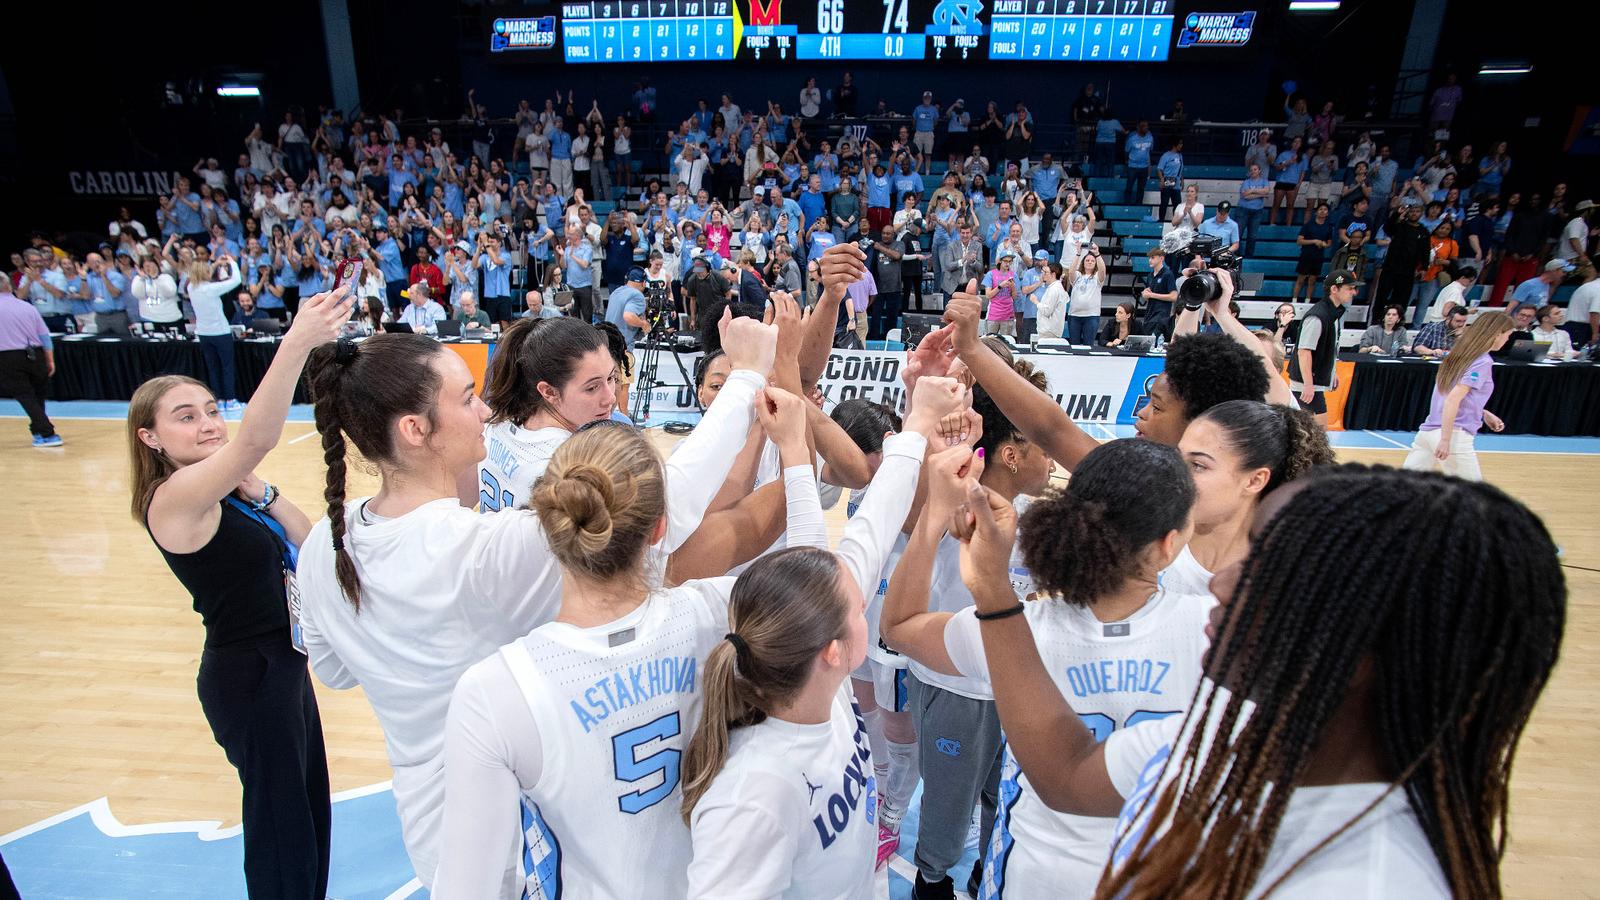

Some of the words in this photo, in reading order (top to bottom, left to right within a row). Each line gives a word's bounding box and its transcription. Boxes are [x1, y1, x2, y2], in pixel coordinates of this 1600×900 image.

[563, 5, 589, 17] PLAYER
[603, 5, 611, 16] 3
[631, 4, 639, 16] 6
[660, 4, 667, 16] 7
[685, 3, 699, 15] 10
[713, 3, 727, 15] 12
[993, 1, 1022, 13] PLAYER
[1036, 1, 1045, 13] 0
[1066, 1, 1075, 13] 2
[1096, 1, 1105, 14] 7
[1123, 1, 1138, 14] 17
[1151, 1, 1166, 14] 21
[817, 0, 844, 34] 66
[882, 0, 909, 34] 74
[1197, 15, 1236, 28] MARCH
[505, 20, 538, 32] MARCH
[564, 26, 590, 37] POINTS
[603, 26, 615, 38] 13
[632, 25, 640, 37] 2
[657, 25, 669, 37] 21
[686, 24, 698, 36] 12
[992, 22, 1020, 33] POINTS
[1031, 23, 1046, 35] 20
[1062, 23, 1076, 35] 14
[1119, 23, 1134, 35] 21
[1152, 24, 1161, 36] 2
[509, 32, 554, 44] MADNESS
[1200, 28, 1250, 41] MADNESS
[746, 36, 770, 48] FOULS
[776, 36, 791, 48] TOL
[819, 36, 841, 57] 4TH
[884, 36, 904, 57] 0.0
[933, 36, 947, 48] TOL
[955, 36, 979, 48] FOULS
[567, 46, 590, 57] FOULS
[605, 47, 613, 59] 2
[633, 46, 641, 58] 3
[661, 46, 668, 57] 3
[688, 46, 696, 57] 3
[716, 45, 724, 56] 4
[755, 48, 760, 59] 5
[780, 48, 786, 59] 0
[936, 48, 942, 59] 2
[962, 48, 968, 59] 5
[992, 42, 1016, 53] FOULS
[1032, 45, 1041, 56] 3
[1062, 45, 1070, 56] 3
[1091, 45, 1100, 57] 2
[1120, 45, 1129, 57] 4
[1151, 45, 1157, 57] 1
[1241, 129, 1258, 146] 118
[820, 354, 900, 382] COND
[656, 392, 669, 401] BY
[1066, 659, 1171, 698] QUEIROZ
[570, 656, 697, 733] ASTAKHOVA
[611, 711, 682, 815] 5
